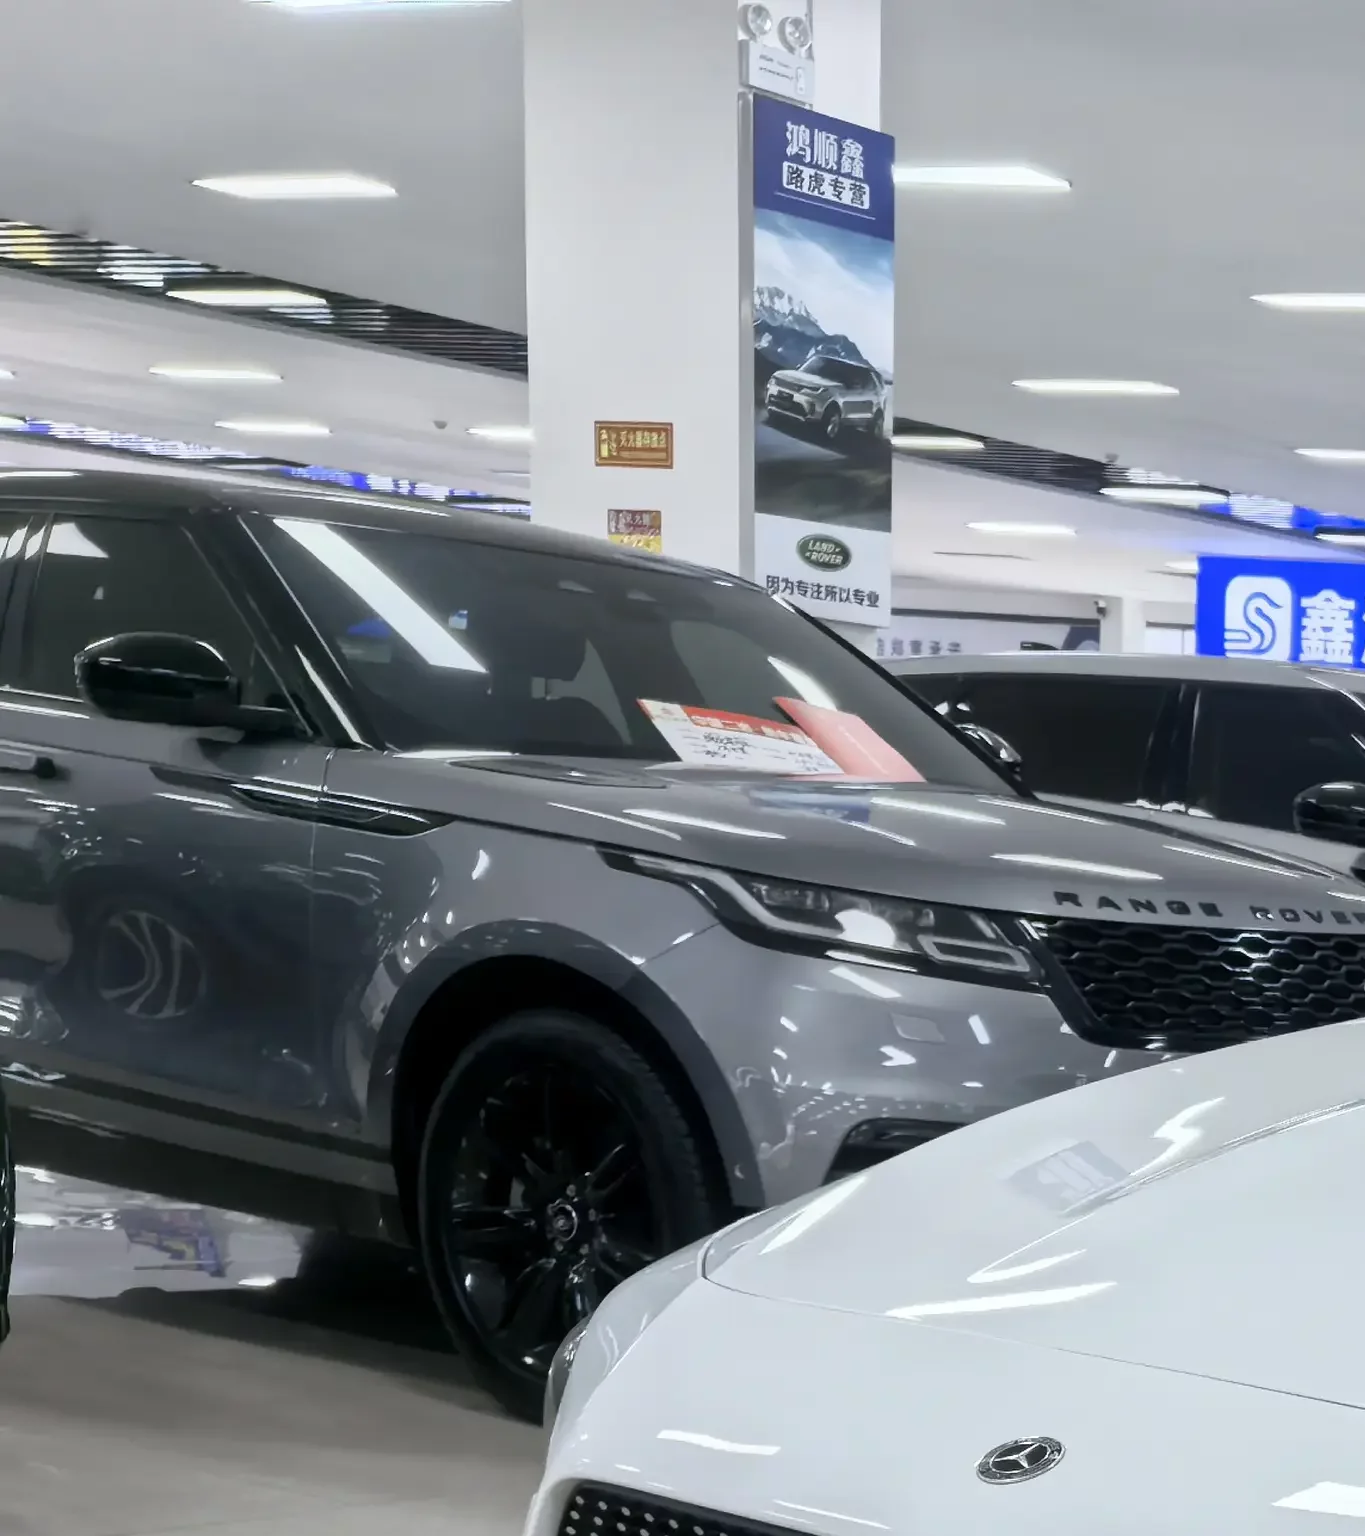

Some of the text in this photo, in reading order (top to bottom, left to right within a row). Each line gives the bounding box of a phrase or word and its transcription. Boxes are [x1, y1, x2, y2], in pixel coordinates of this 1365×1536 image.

[786, 121, 864, 179] 鸿顺鑫
[786, 164, 867, 207] 路虎专营
[808, 540, 835, 553] LAND
[811, 552, 843, 564] ROVER
[766, 575, 880, 608] 因为专注所以专业
[1054, 891, 1223, 918] RANGE
